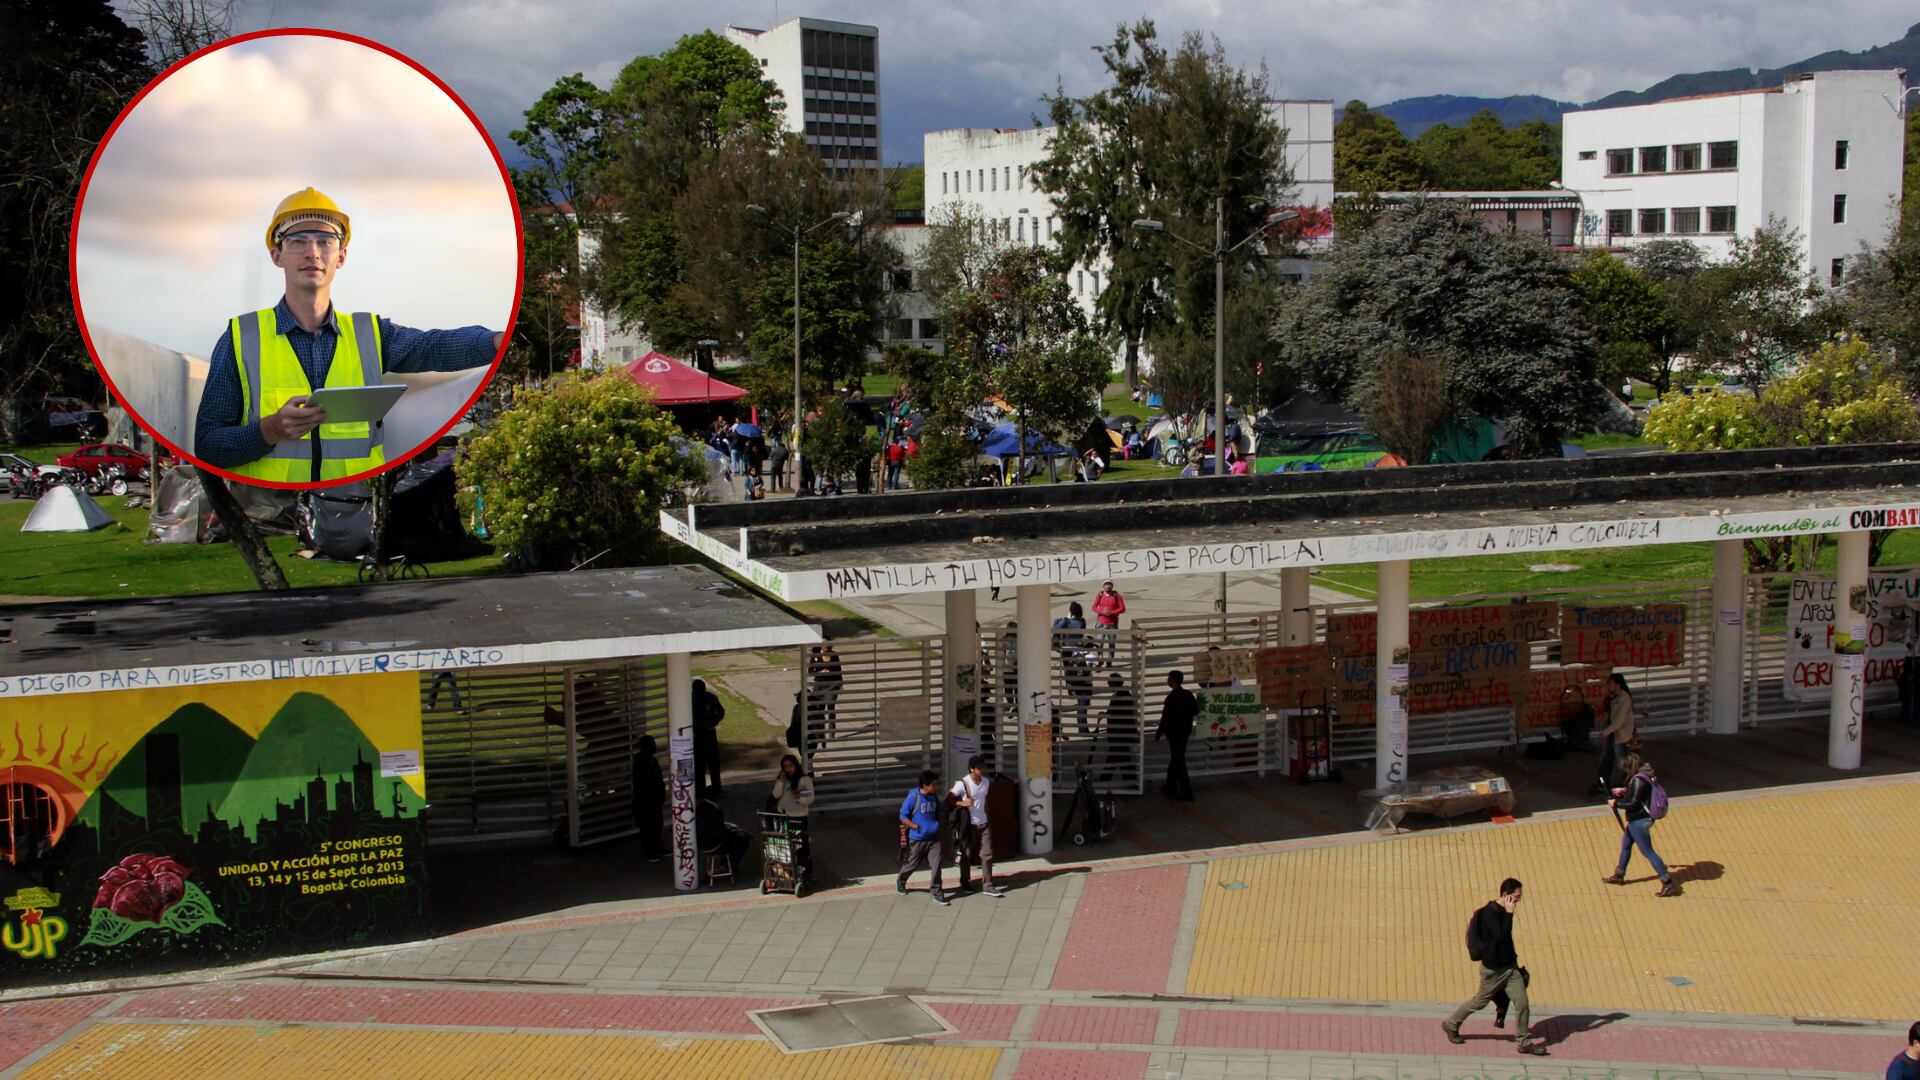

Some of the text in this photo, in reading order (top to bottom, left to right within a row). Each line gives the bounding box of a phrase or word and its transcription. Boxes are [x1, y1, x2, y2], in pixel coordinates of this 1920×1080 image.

[1822, 516, 1841, 527] al
[1850, 508, 1920, 529] COMBAT
[1478, 532, 1496, 549] LA
[1506, 525, 1558, 547] NUEVA
[1569, 519, 1660, 543] COLOMBIA
[826, 540, 1324, 596] MANTILLA TU HOSPITAL ES DE PACOTILLA!
[1792, 580, 1816, 601] EN
[1418, 608, 1501, 627] PARALELA
[1430, 625, 1506, 647] contratos
[1600, 629, 1613, 640] en
[1647, 625, 1662, 640] de
[1445, 641, 1520, 673] RECTOR
[18, 674, 91, 694] DIGNO
[100, 668, 160, 689] PARA
[168, 662, 266, 685] NUESTRO
[301, 650, 503, 677] UNIVERSITARIO
[335, 835, 402, 851] CONGRESO
[218, 848, 404, 877] UNIDAD Y ACCIÓN POR LA PAZ
[248, 876, 266, 888] 13,
[268, 873, 283, 884] 14
[285, 874, 293, 884] y
[296, 871, 310, 881] 15
[312, 869, 327, 879] de
[360, 864, 374, 874] de
[377, 861, 405, 873] 2013
[351, 874, 406, 889] Colombia
